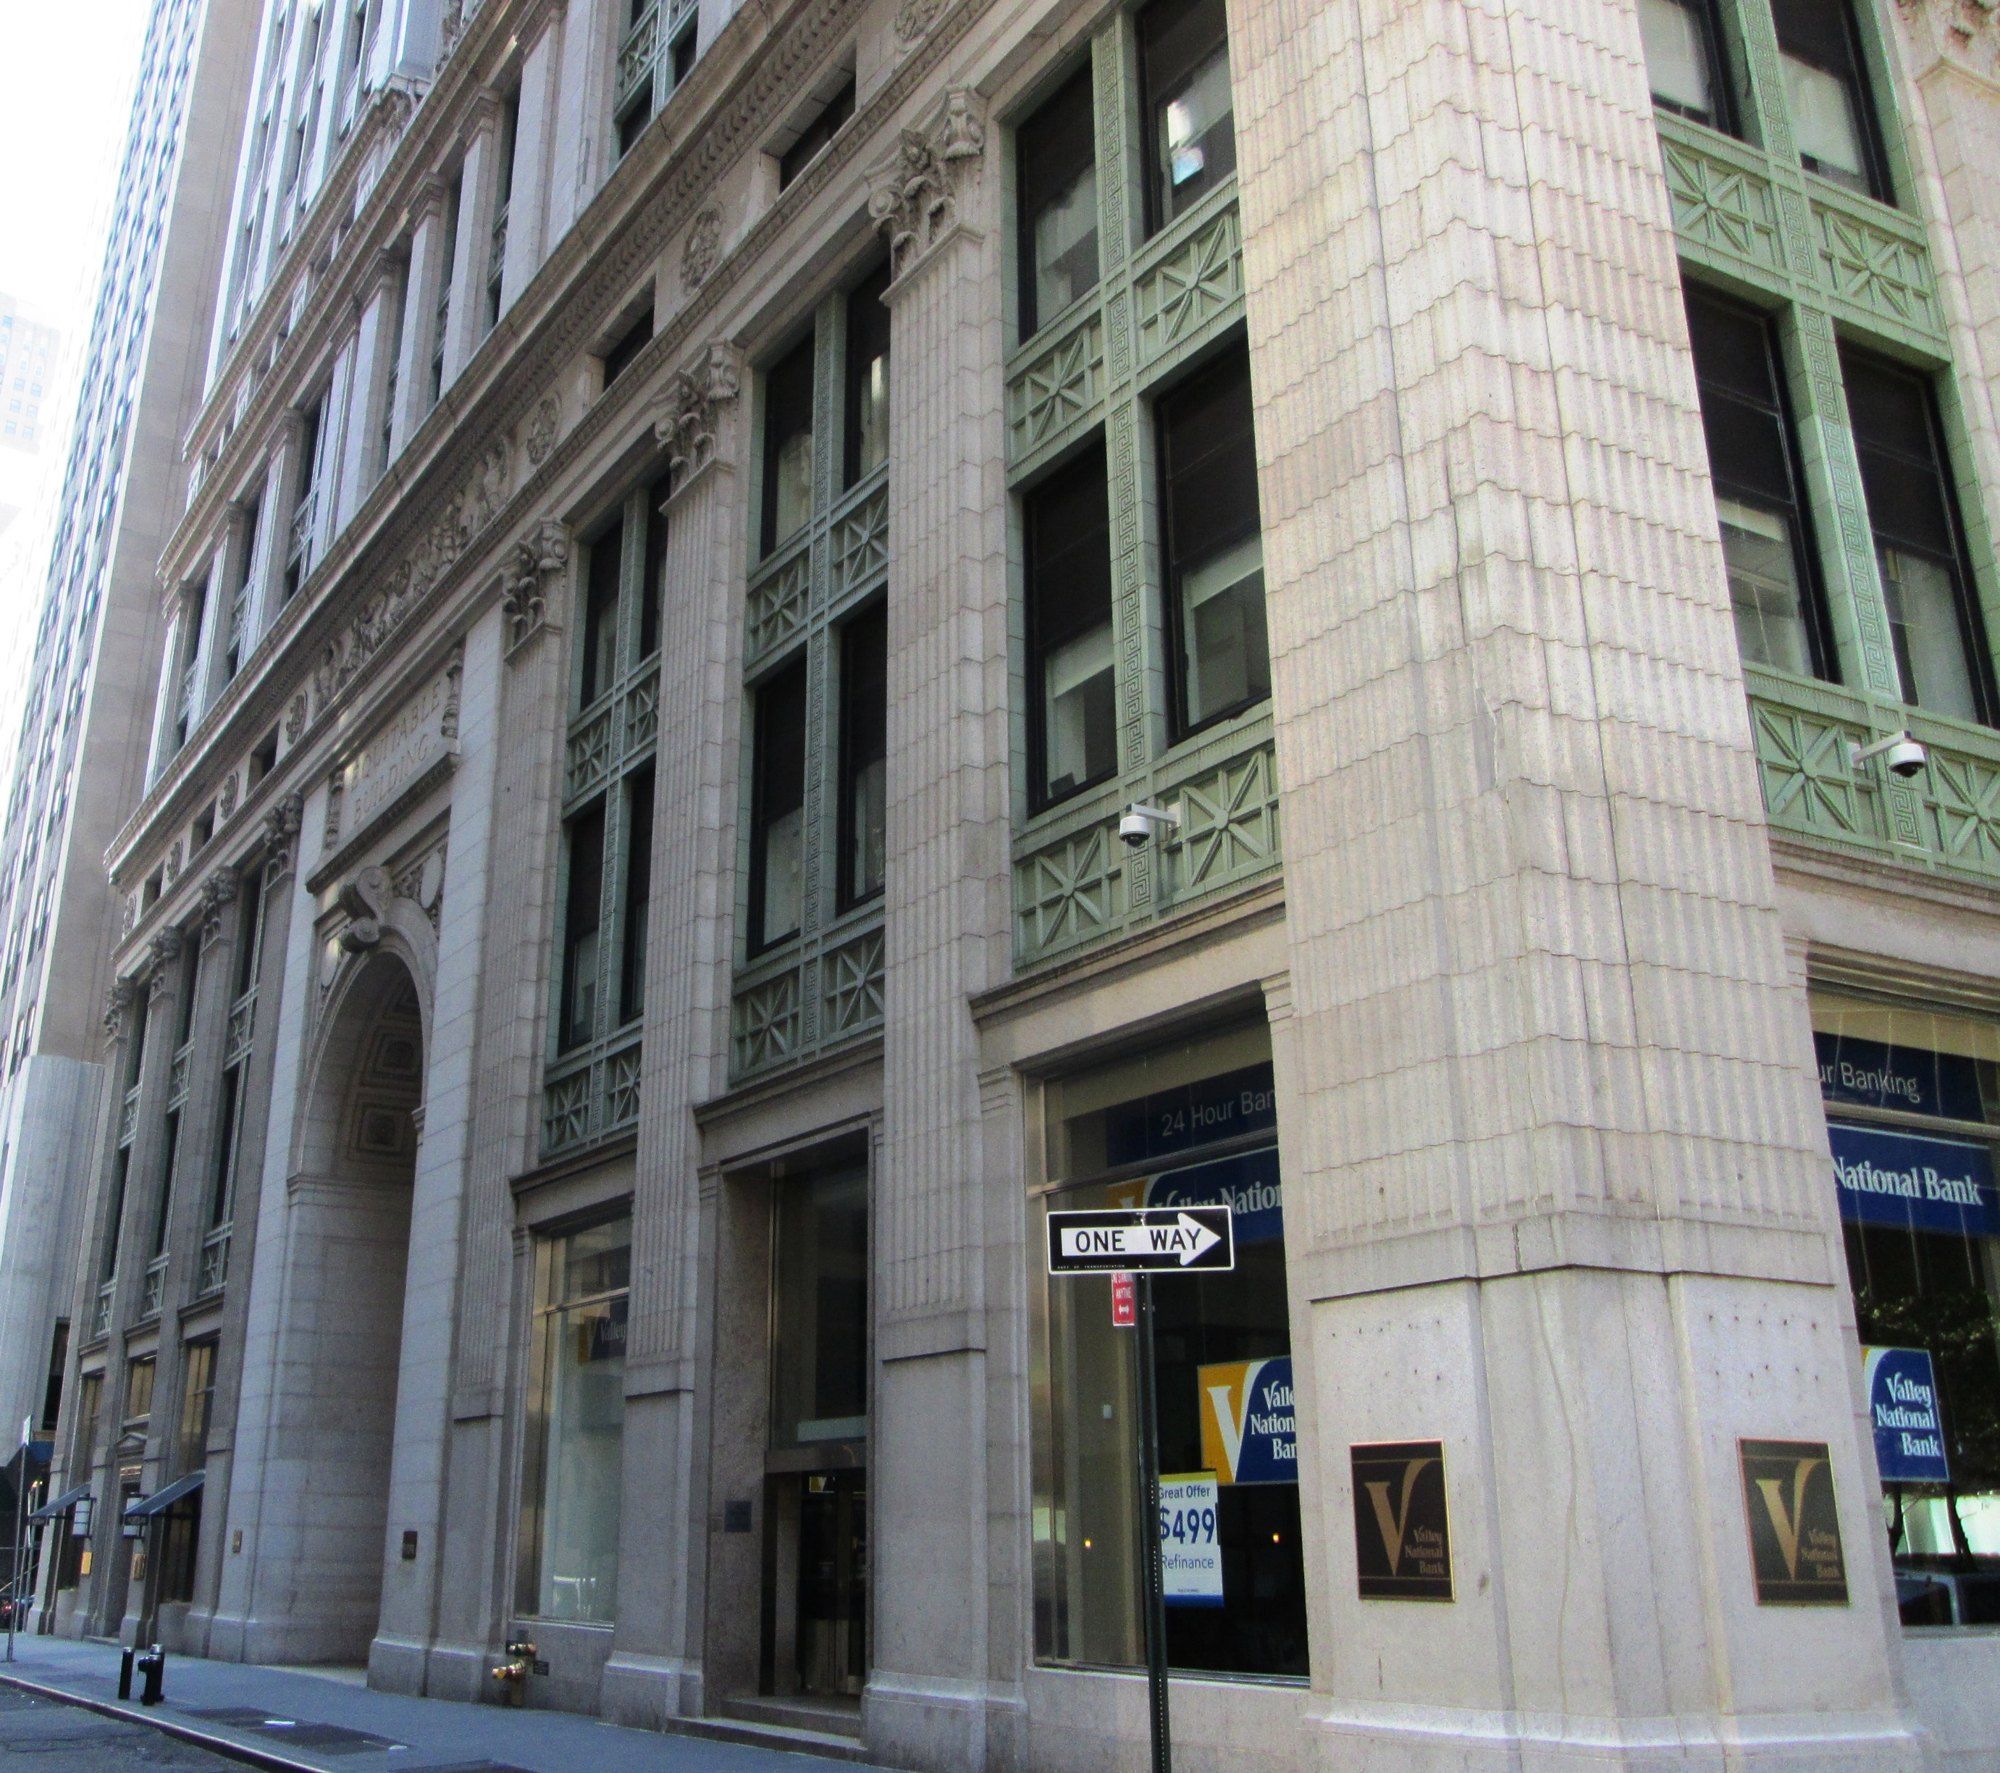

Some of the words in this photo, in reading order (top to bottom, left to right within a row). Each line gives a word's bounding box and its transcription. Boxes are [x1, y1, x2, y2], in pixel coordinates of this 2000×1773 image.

[1840, 1062, 1920, 1104] Banking
[1161, 1111, 1185, 1137] 24
[1191, 1100, 1235, 1128] Hour
[1833, 1156, 1922, 1199] National
[1921, 1167, 1984, 1207] Bank
[1075, 1230, 1126, 1253] ONE
[1150, 1228, 1202, 1251] WAY
[1885, 1371, 1932, 1408] Valley
[1875, 1403, 1936, 1430] National
[1900, 1432, 1942, 1457] Bank
[1159, 1487, 1184, 1500] Great
[1186, 1484, 1211, 1499] Offer
[1160, 1505, 1216, 1545] $499
[1162, 1552, 1215, 1570] Refinance
[1418, 1560, 1445, 1575] Bank
